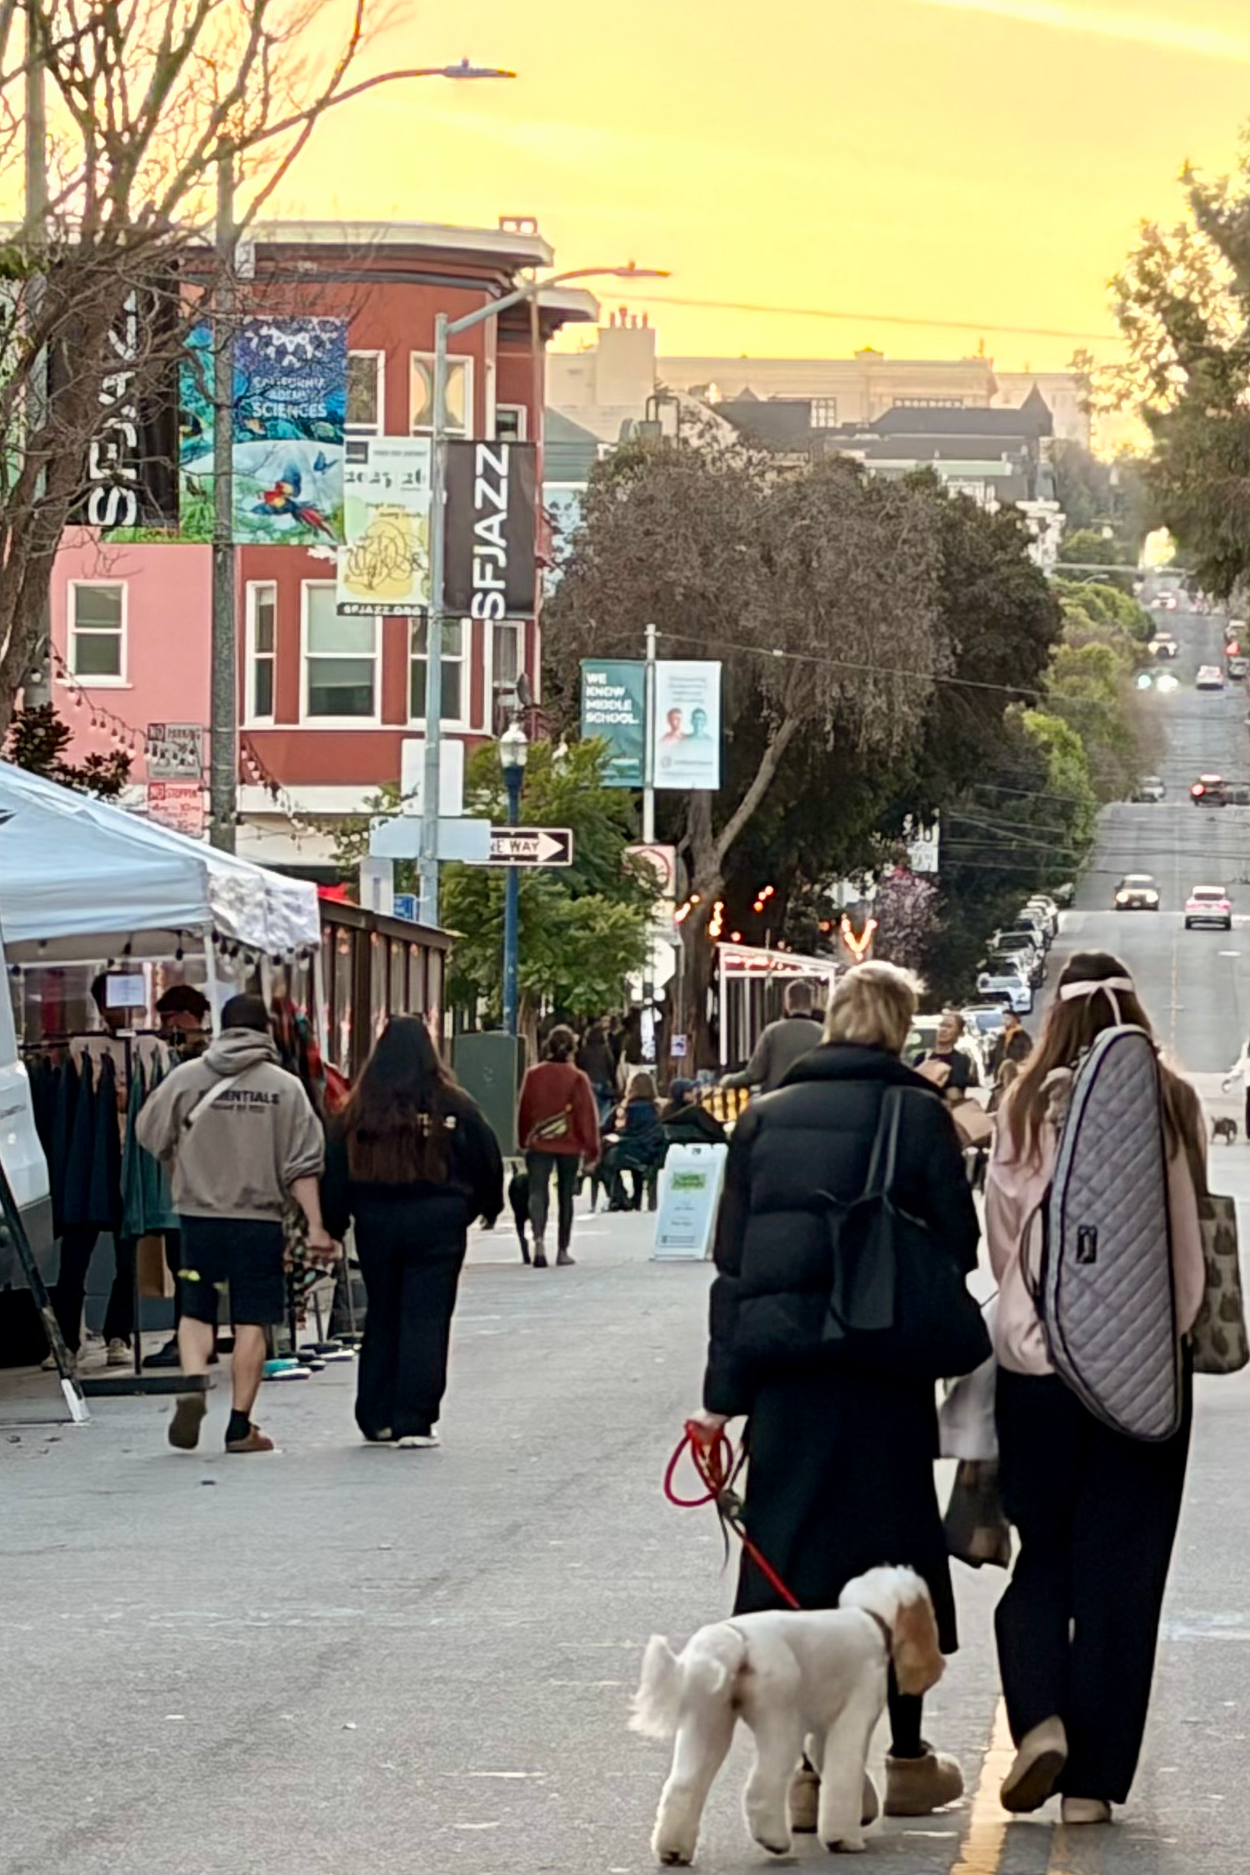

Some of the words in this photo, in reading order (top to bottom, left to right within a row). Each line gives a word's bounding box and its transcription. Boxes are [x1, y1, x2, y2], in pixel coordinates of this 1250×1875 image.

[252, 402, 327, 418] SCIENCES
[472, 443, 509, 619] SFJAZZ
[586, 673, 606, 684] WE
[586, 686, 625, 697] KNOW
[586, 699, 632, 711] MIDDLE
[510, 841, 539, 853] WAY
